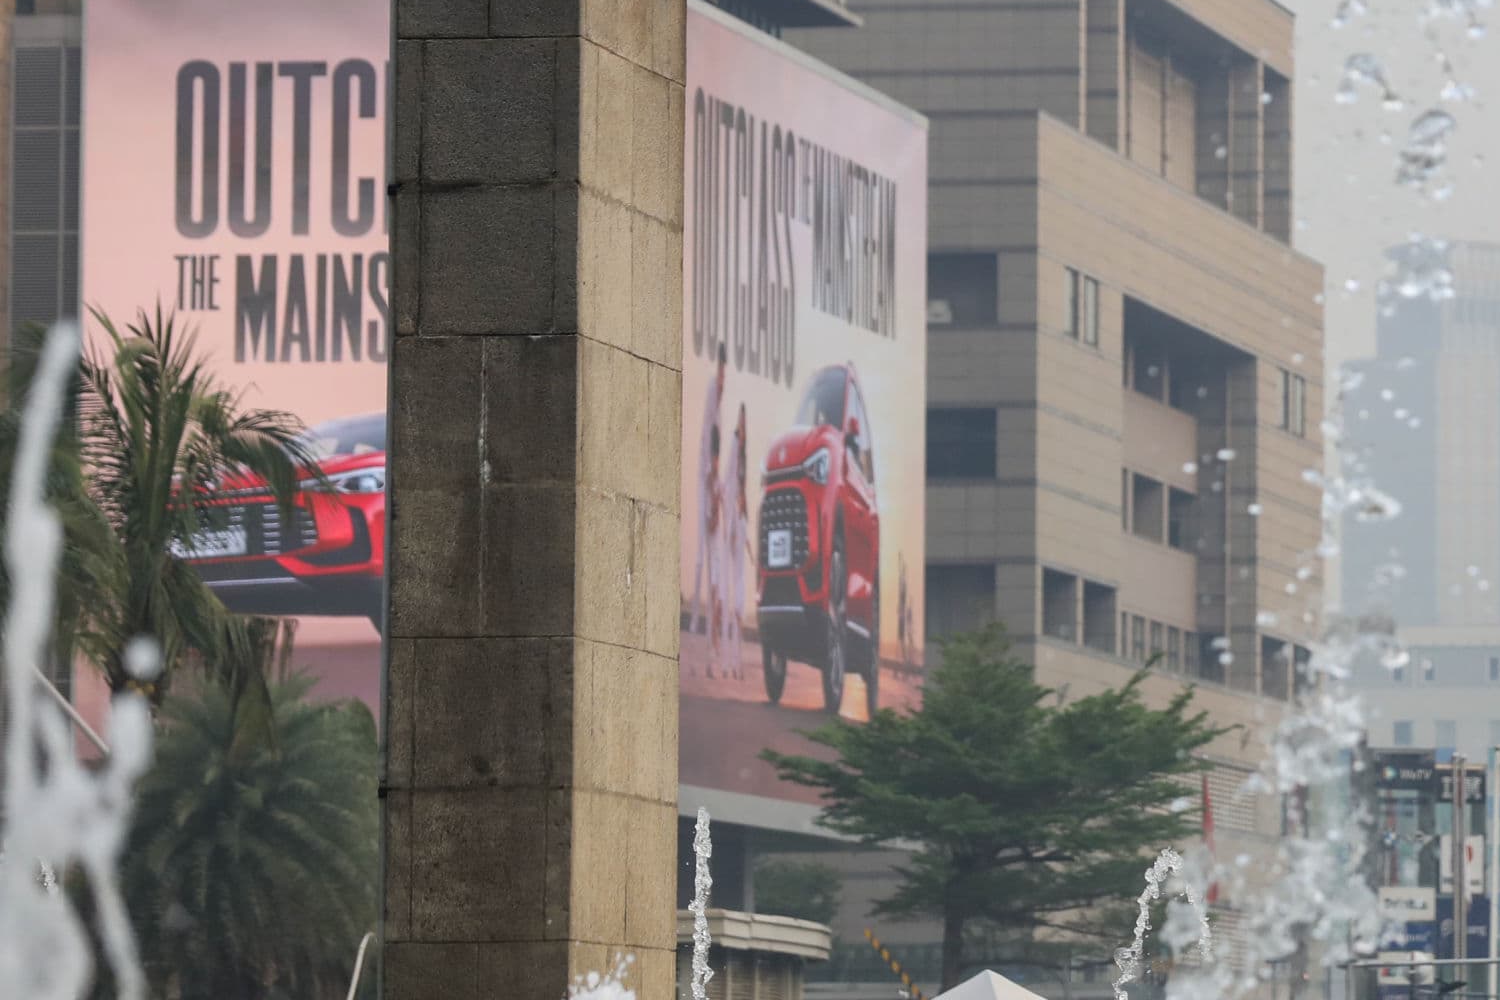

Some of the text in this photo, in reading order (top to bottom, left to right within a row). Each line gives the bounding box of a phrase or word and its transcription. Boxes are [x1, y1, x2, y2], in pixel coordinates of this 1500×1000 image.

[174, 57, 391, 239] OUTC
[692, 85, 797, 390] OUTCLASS
[174, 254, 222, 312] THE
